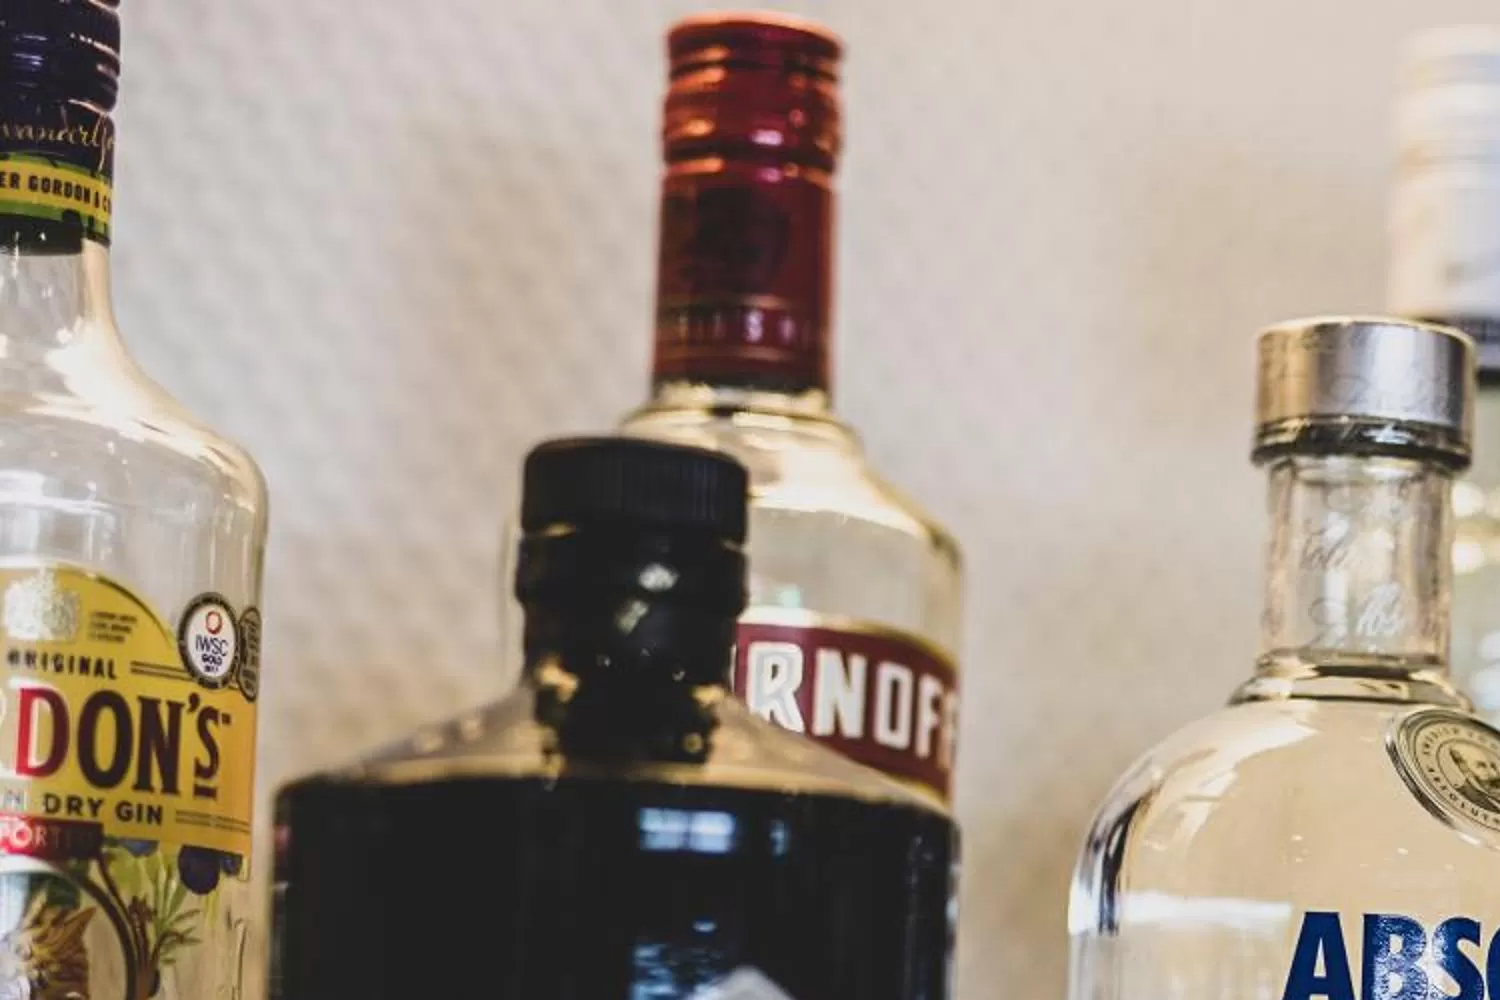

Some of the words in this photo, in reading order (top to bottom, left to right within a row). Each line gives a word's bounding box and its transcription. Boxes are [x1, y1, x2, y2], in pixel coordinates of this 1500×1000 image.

[28, 175, 91, 205] GORDON
[195, 634, 229, 657] IWSC
[7, 650, 117, 680] ORIGINAL
[732, 640, 957, 772] RNOF
[42, 792, 104, 818] DRY
[115, 800, 163, 826] GIN
